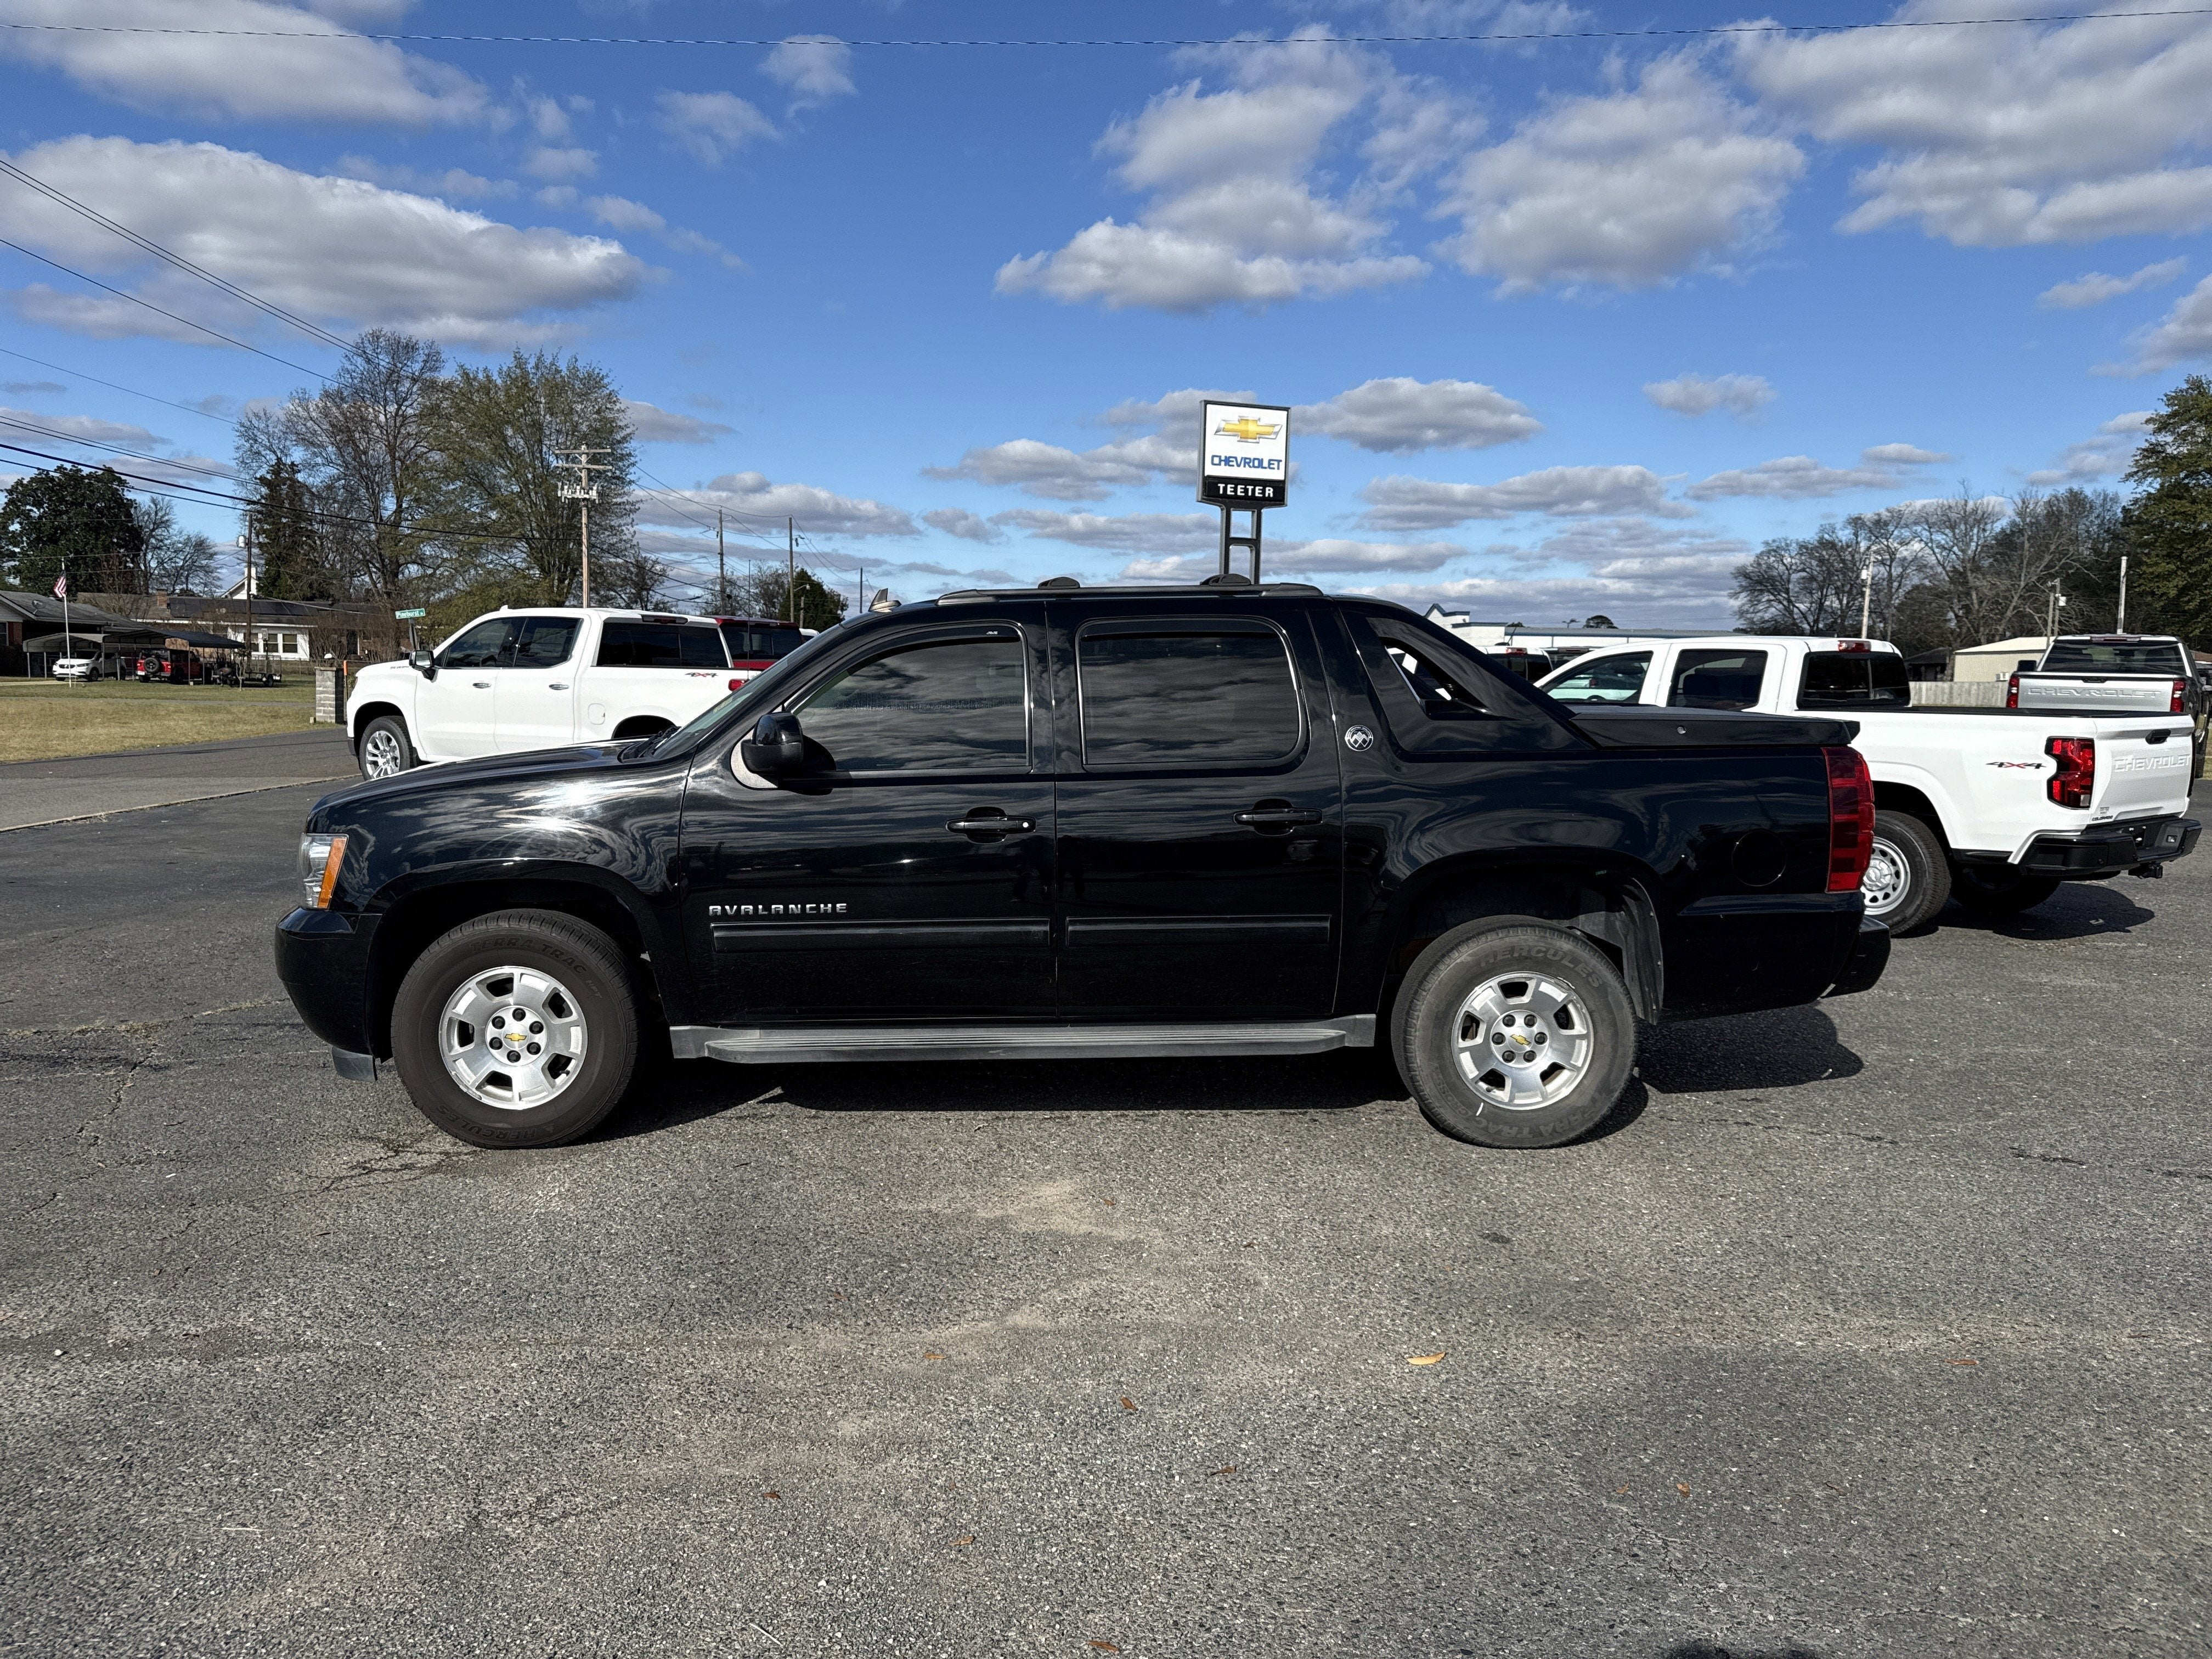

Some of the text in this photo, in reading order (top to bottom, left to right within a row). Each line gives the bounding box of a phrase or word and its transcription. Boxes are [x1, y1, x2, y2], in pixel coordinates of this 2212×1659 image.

[1211, 455, 1282, 470] CHEVROLET
[1218, 483, 1273, 497] TEETER
[2028, 688, 2161, 698] CHEVROLET
[2114, 754, 2191, 772] CHEVROLET
[709, 903, 847, 916] AVALANCHE
[470, 938, 534, 953] TERRA
[540, 943, 588, 974] TRAC
[1480, 945, 1604, 988] HERCULES
[436, 1104, 537, 1140] HERCULES
